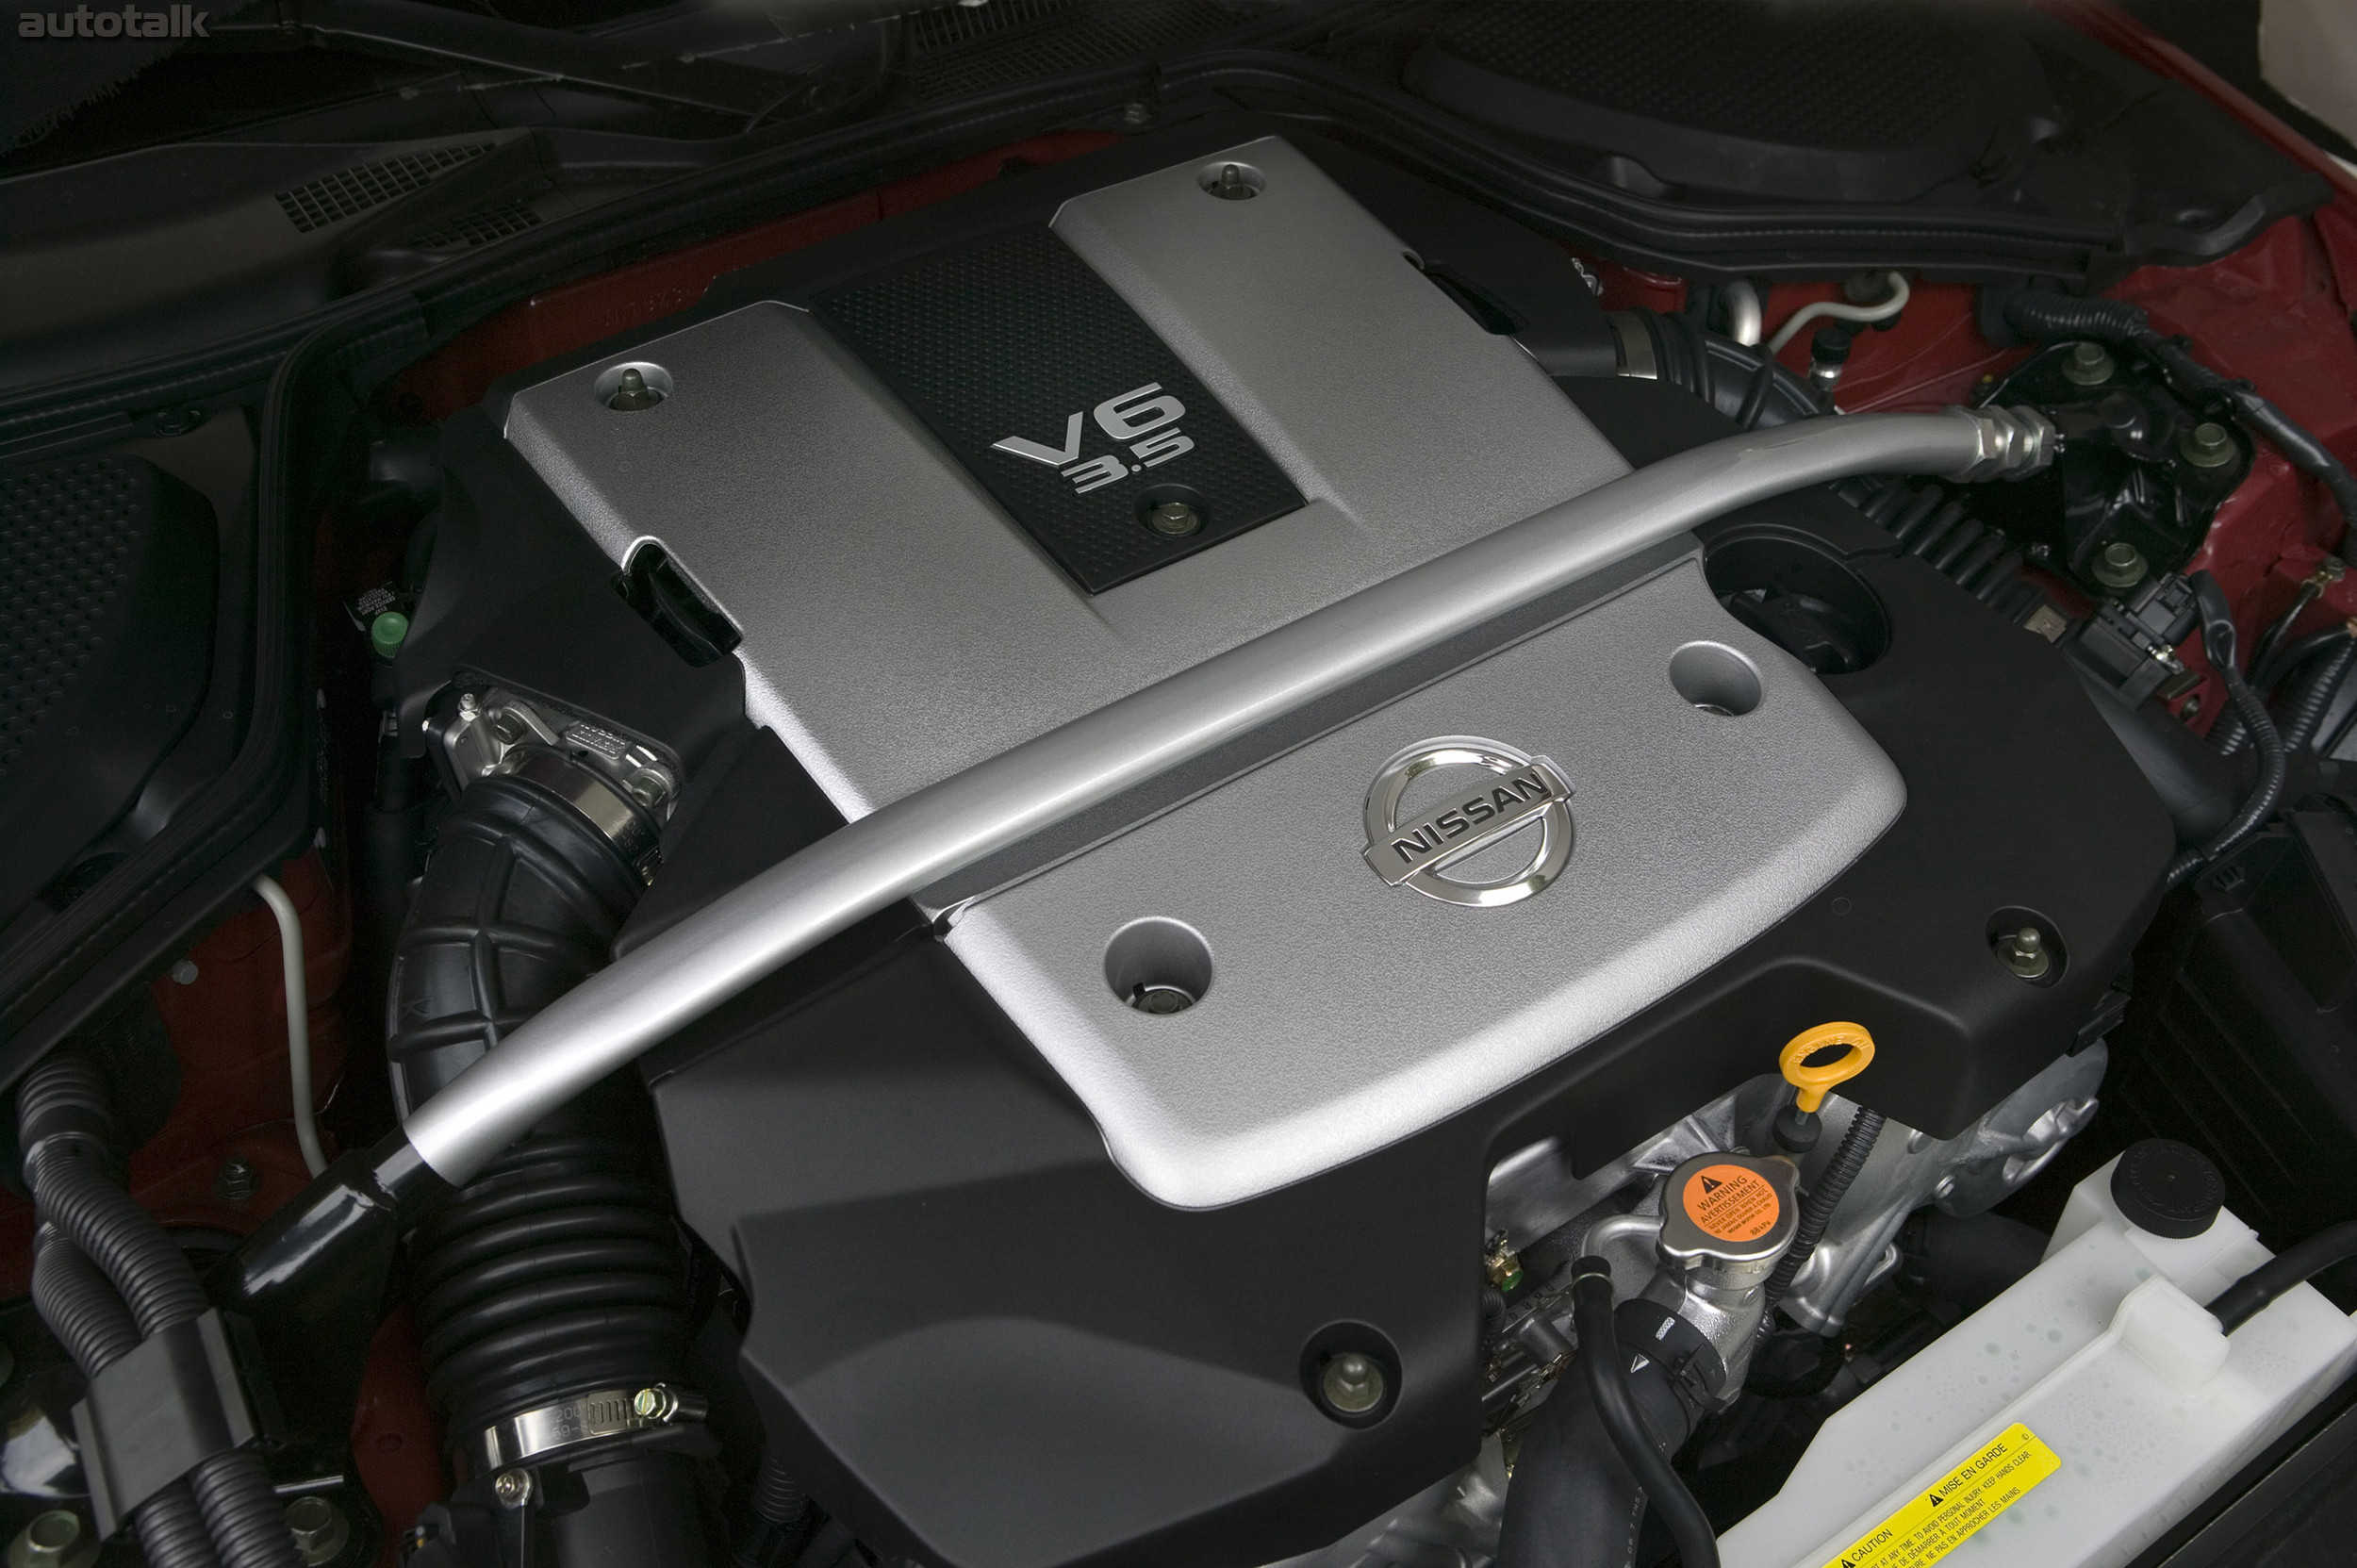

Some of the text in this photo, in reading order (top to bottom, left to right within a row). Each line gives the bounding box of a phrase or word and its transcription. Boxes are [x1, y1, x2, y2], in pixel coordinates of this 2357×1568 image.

[991, 382, 1186, 467] V6
[1061, 427, 1195, 494] 3.5
[1391, 771, 1552, 865] NISSAN
[1697, 1175, 1748, 1212] WARNING
[1700, 1179, 1760, 1225] AVERTISSEMENT
[1851, 1443, 2008, 1562] CAUTION MISE EN GARDE
[1914, 1531, 1924, 1541] TO
[1922, 1520, 1939, 1536] AVOID
[1937, 1502, 1966, 1524] PERSONAL
[1982, 1477, 1996, 1491] KEEP
[1995, 1463, 2015, 1480] HANDS
[1925, 1550, 1937, 1560] NE
[1934, 1541, 1949, 1554] PAS
[1947, 1534, 1958, 1544] EN
[1956, 1510, 1990, 1537] APPROCHER
[1988, 1501, 2002, 1513] LES
[1944, 1516, 1961, 1531] TOUT
[1959, 1498, 1986, 1520] MOMENT
